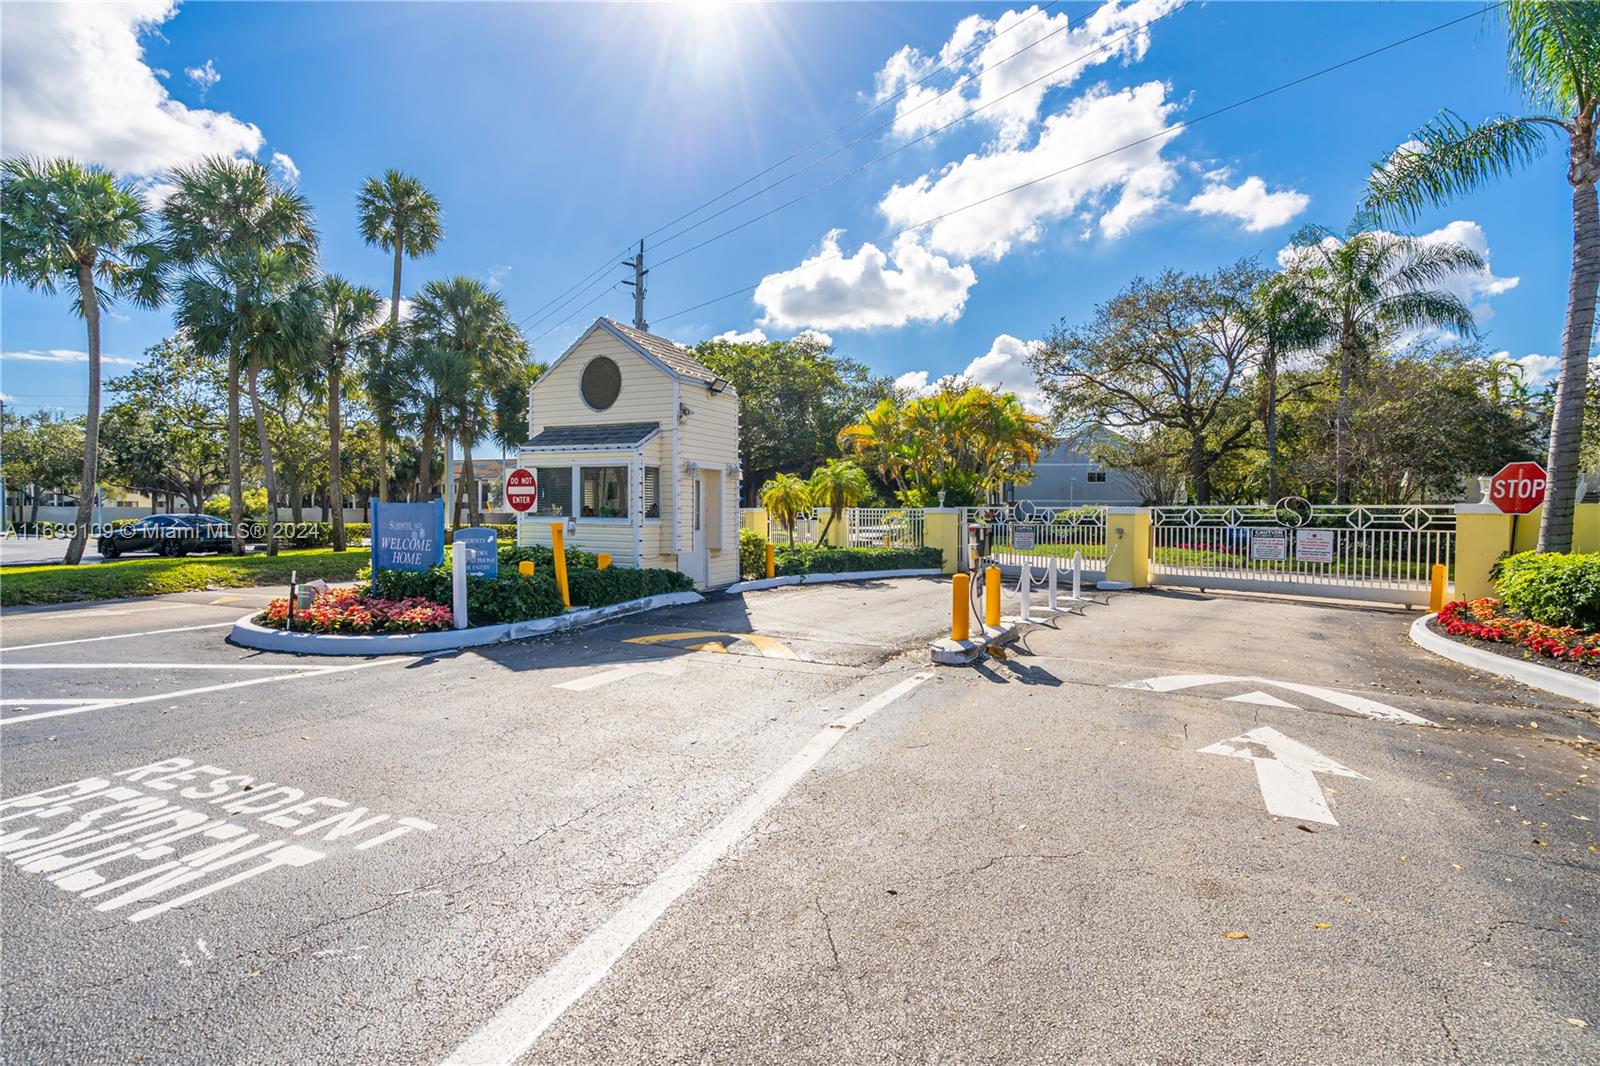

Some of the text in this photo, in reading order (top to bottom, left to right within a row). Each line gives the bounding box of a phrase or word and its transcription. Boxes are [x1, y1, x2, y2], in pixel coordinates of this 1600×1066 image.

[510, 477, 532, 485] DO NOT
[1493, 479, 1546, 499] STOP
[512, 496, 530, 504] ENTER
[382, 537, 433, 551] WELCOME
[392, 551, 422, 565] HOME
[114, 757, 438, 850] RESIDENT
